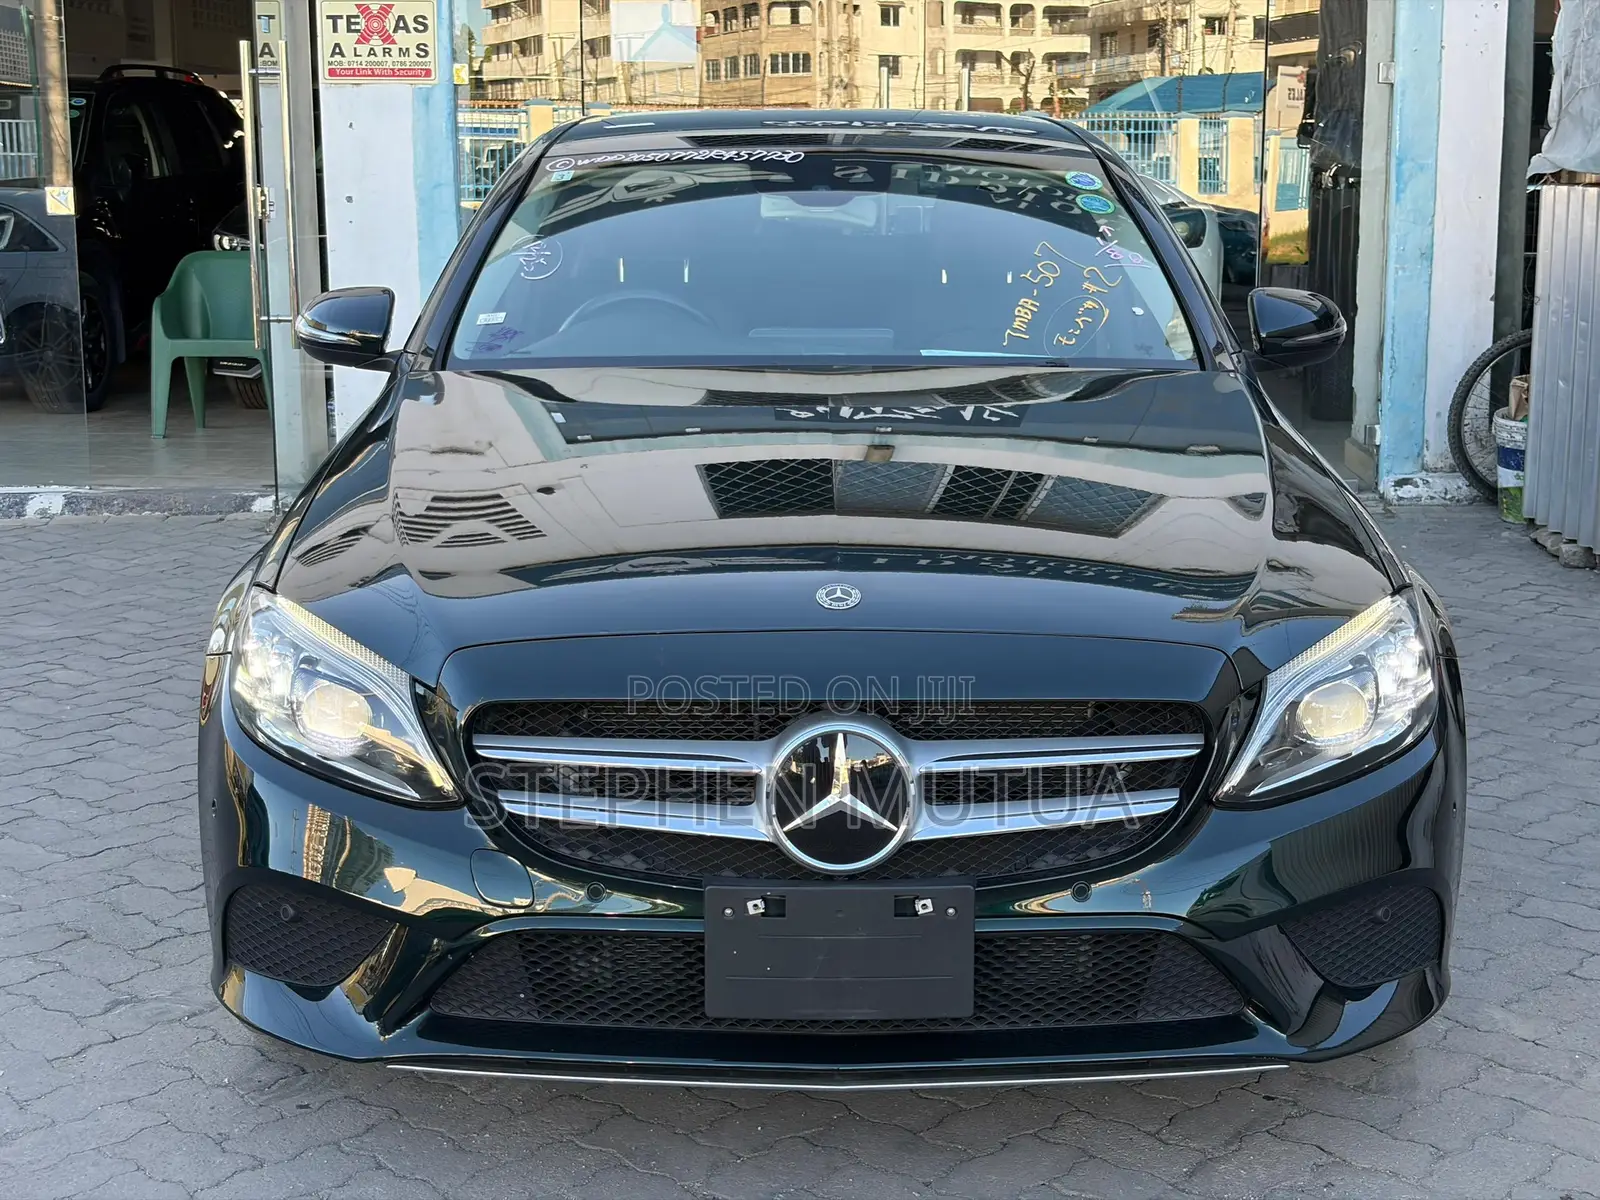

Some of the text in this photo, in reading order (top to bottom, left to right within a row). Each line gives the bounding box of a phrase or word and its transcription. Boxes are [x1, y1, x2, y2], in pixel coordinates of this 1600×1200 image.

[326, 4, 429, 45] TEXAS
[330, 43, 430, 58] ALARMS
[335, 68, 426, 77] Your Link With Security
